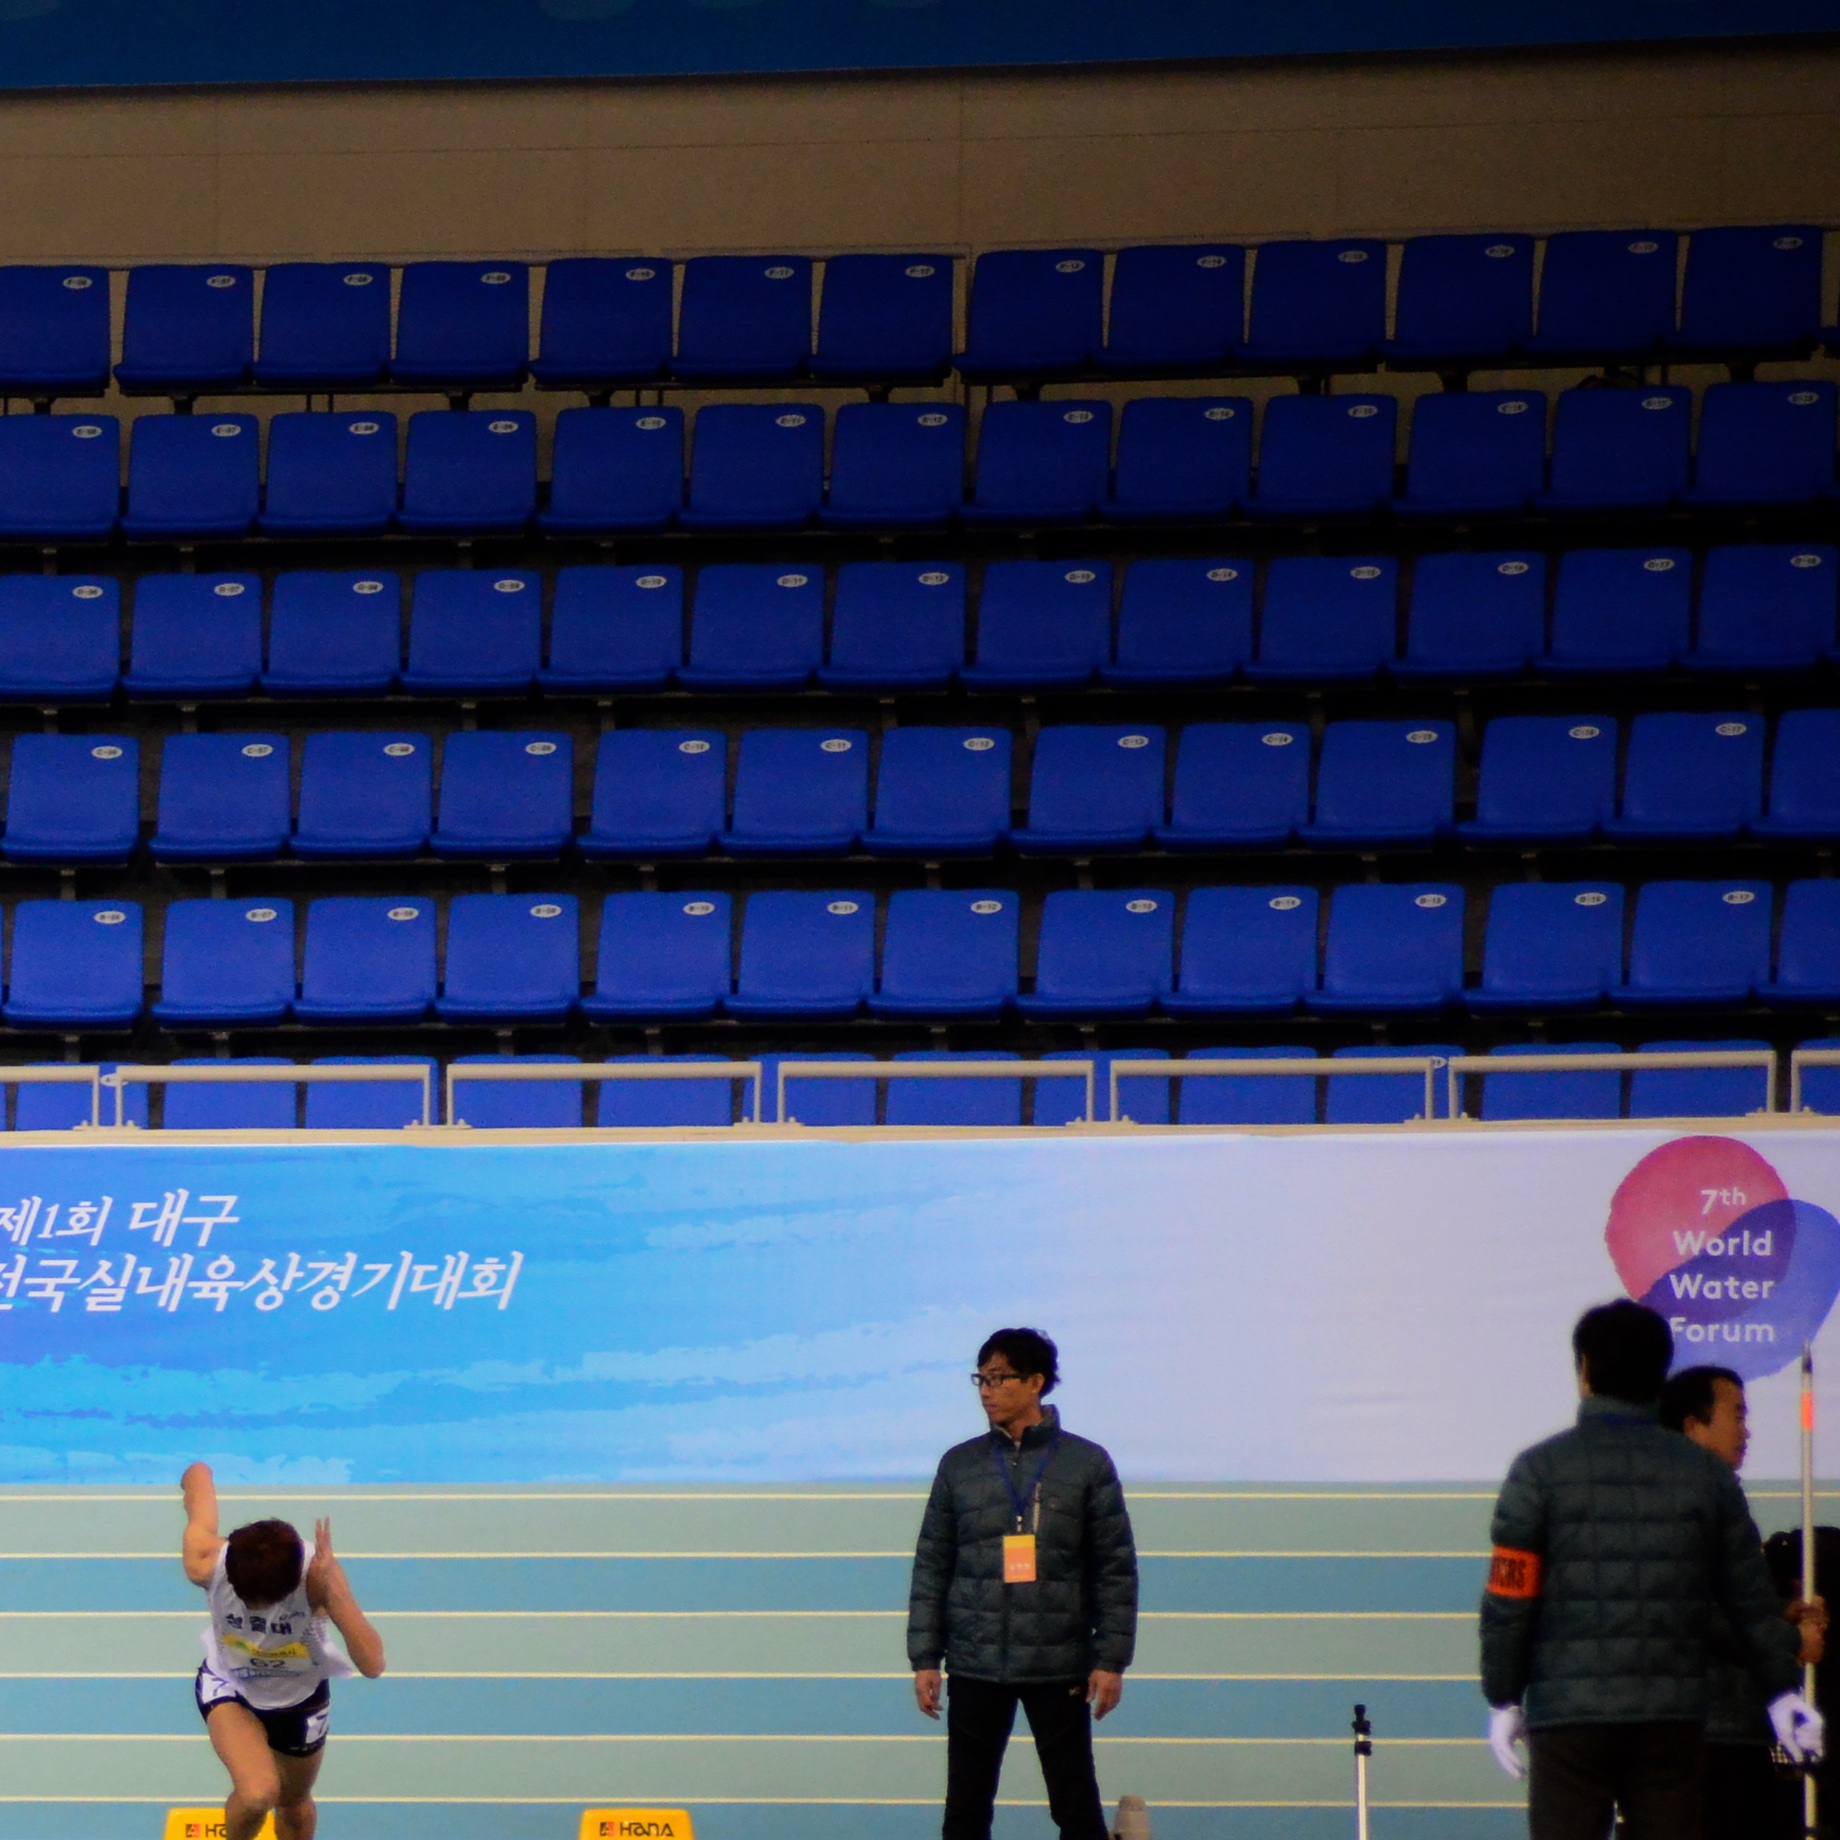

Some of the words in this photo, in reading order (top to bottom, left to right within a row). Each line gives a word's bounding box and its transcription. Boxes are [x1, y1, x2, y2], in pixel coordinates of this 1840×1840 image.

[1701, 1187, 1746, 1215] 7th
[129, 1189, 240, 1248] 대구
[1673, 1230, 1772, 1257] World
[1670, 1273, 1774, 1300] Water
[1671, 1316, 1774, 1343] Forum
